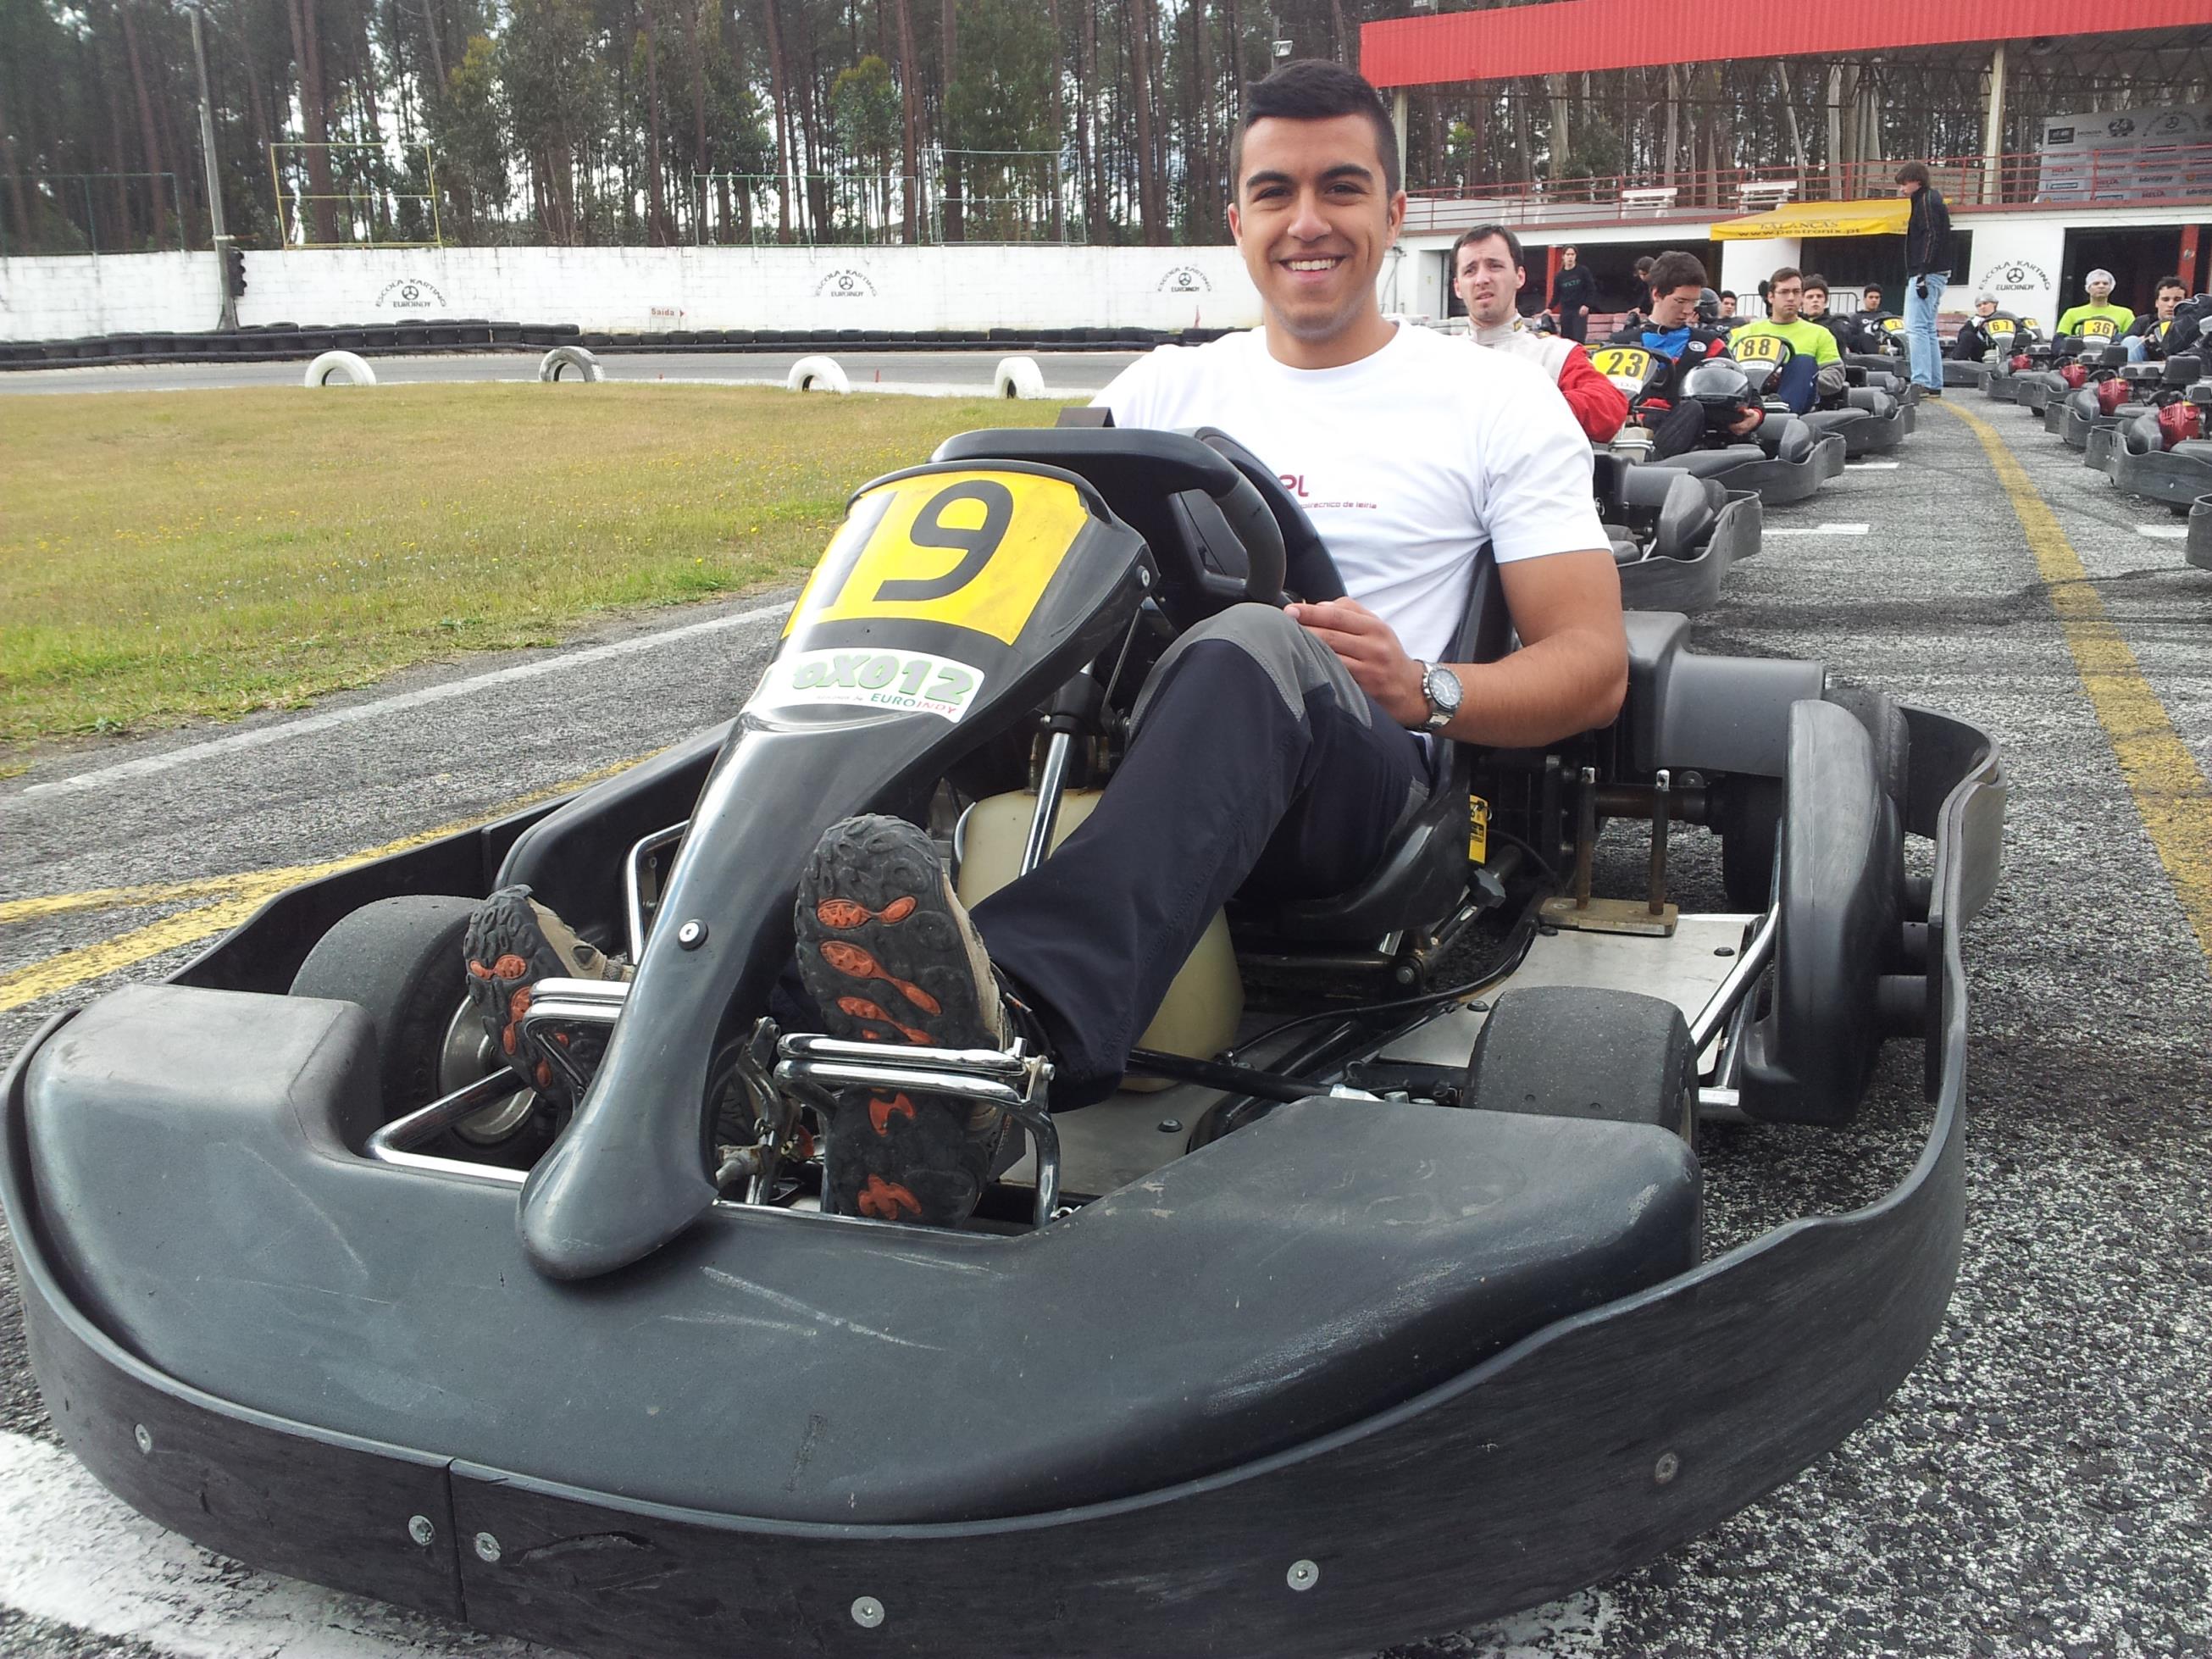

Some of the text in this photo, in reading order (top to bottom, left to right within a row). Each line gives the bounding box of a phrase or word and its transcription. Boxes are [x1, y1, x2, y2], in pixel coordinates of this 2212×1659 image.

[2016, 260, 2051, 291] KARTING
[410, 277, 446, 307] KARTING
[1992, 320, 2010, 331] 67
[2092, 322, 2111, 335] 36
[1743, 338, 1771, 357] 88
[1605, 352, 1644, 377] 23
[870, 692, 957, 714] EUROINDY
